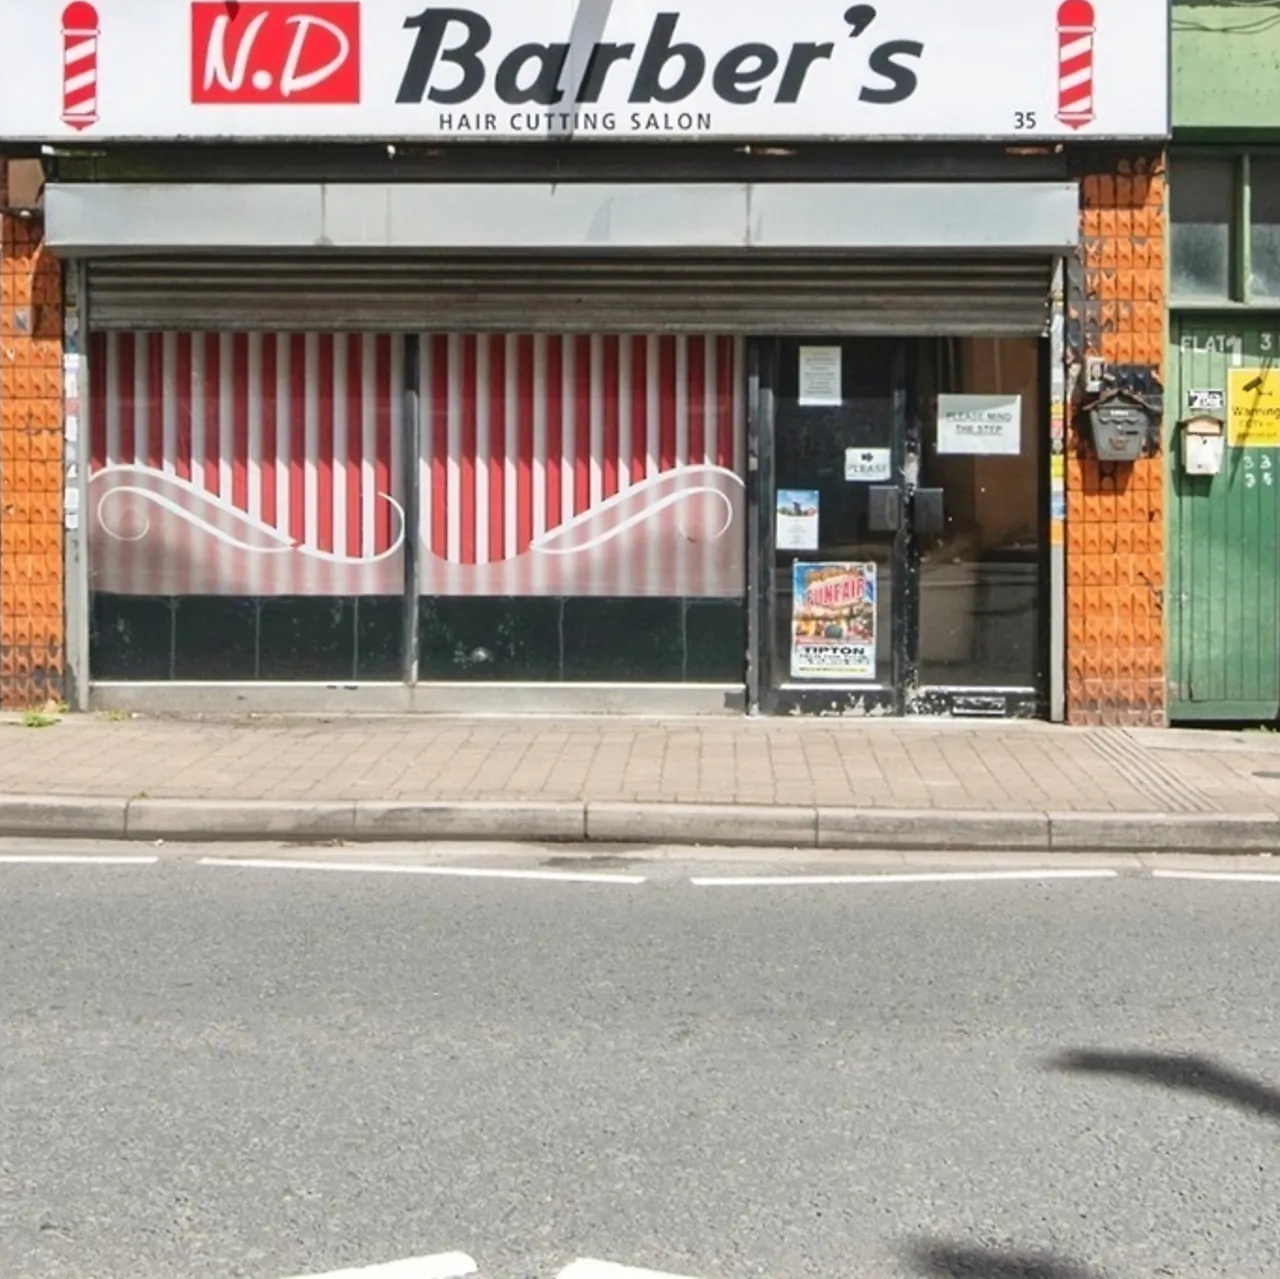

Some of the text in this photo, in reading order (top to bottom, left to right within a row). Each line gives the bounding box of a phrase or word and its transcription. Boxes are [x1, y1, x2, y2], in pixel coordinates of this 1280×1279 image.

[395, 4, 925, 106] Barber's
[439, 113, 712, 131] HAIR CUTTING SALON
[1013, 111, 1037, 130] 35
[1180, 333, 1226, 354] FLAT
[804, 646, 866, 655] TIPTON
